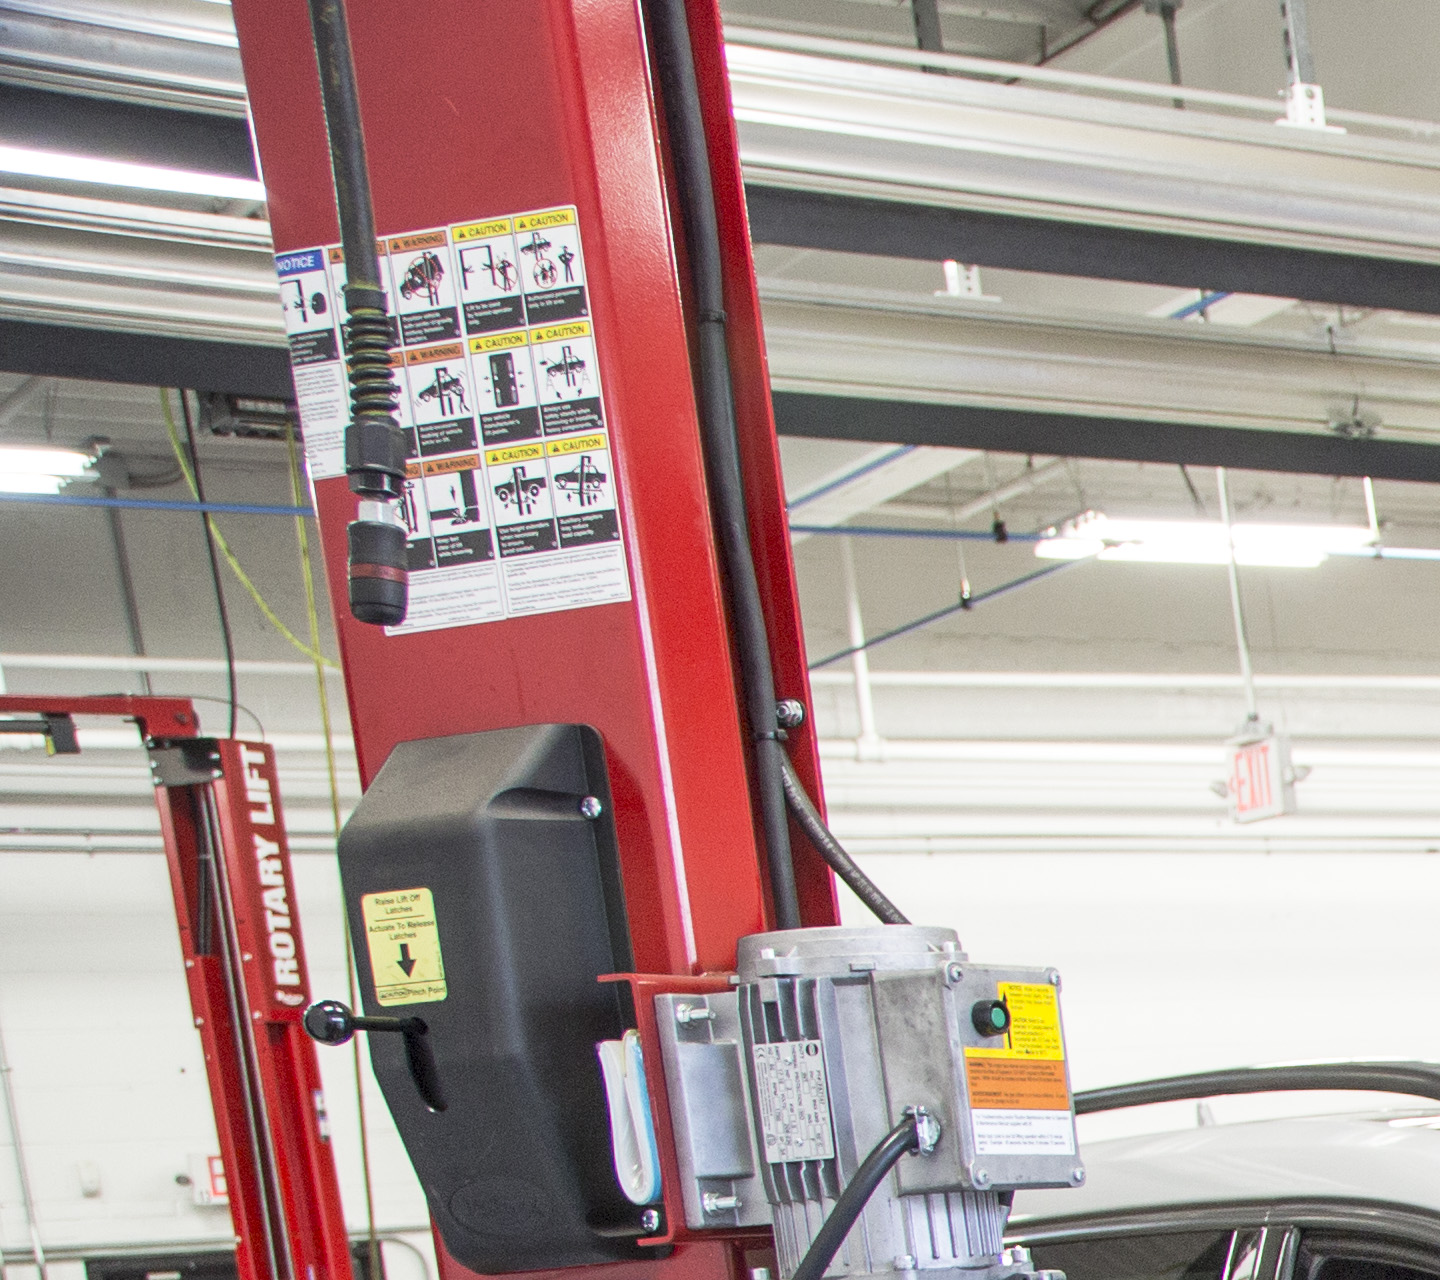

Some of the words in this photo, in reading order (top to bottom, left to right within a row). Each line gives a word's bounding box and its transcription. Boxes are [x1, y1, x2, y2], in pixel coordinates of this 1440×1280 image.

[529, 213, 569, 228] CAUTION
[468, 223, 507, 238] CAUTION
[403, 233, 442, 248] WARNING
[277, 255, 315, 270] NOTICE
[545, 325, 585, 339] CAUTION
[485, 335, 523, 349] CAUTION
[420, 344, 461, 358] WARNING
[562, 438, 601, 452] CAUTION
[501, 447, 540, 461] CAUTION
[435, 457, 476, 472] WARNING
[239, 743, 276, 825] LIFT
[1235, 746, 1272, 812] EXIT
[254, 833, 301, 986] ROTARY
